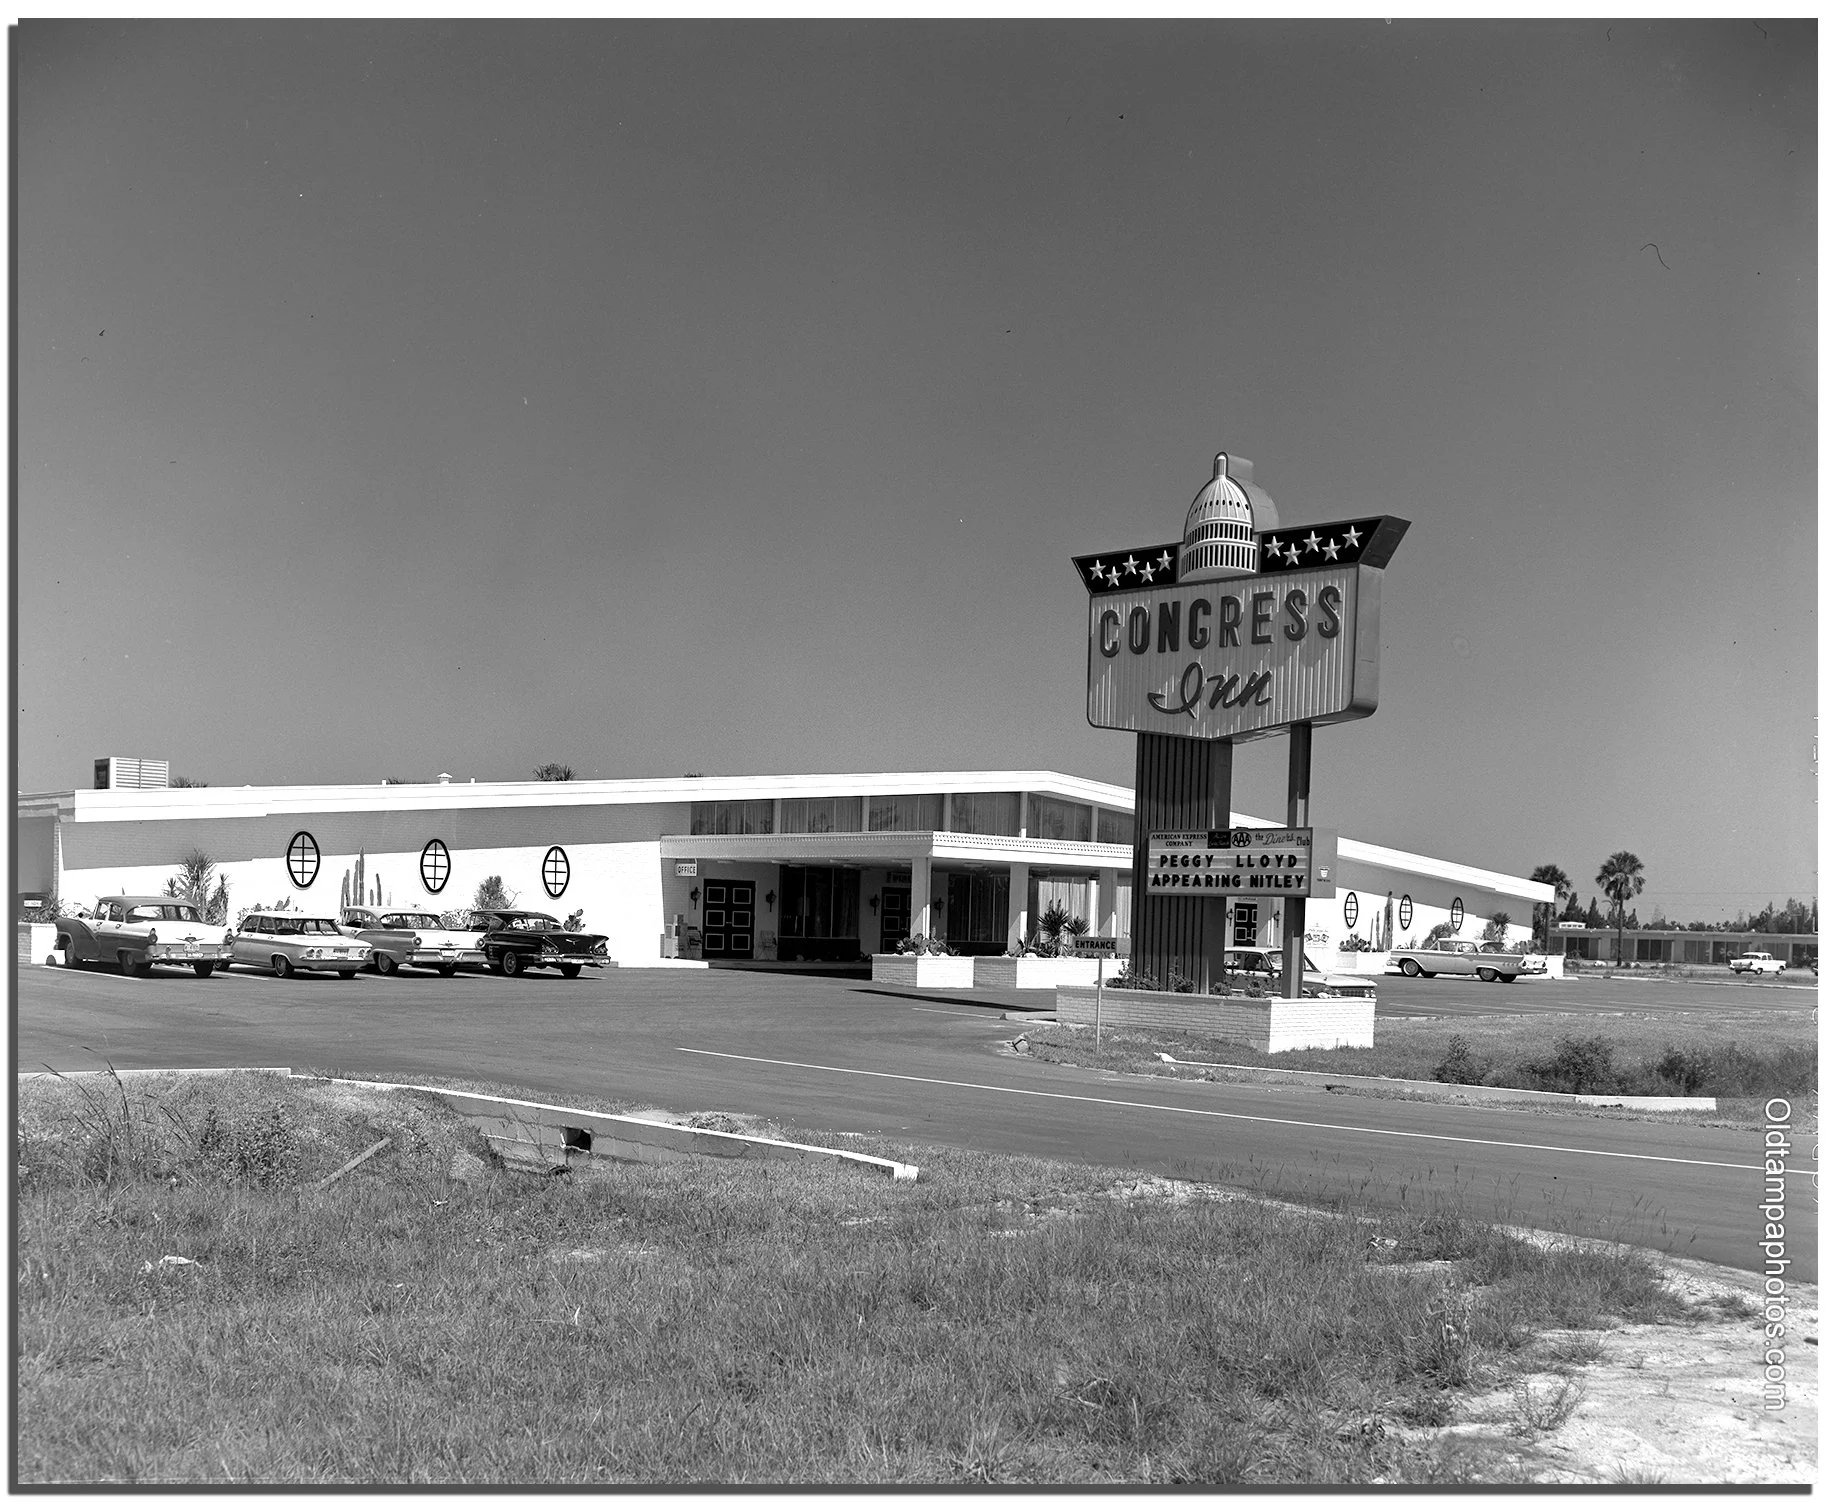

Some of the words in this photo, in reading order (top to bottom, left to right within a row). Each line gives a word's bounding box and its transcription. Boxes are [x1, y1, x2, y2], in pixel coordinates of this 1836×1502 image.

[1100, 585, 1342, 657] CONGRESS
[1147, 662, 1272, 719] Inn
[1232, 832, 1251, 847] AAA
[1160, 855, 1214, 867] PEGGY
[1236, 854, 1298, 867] LLOYD
[677, 865, 697, 875] OFFICE
[1151, 873, 1241, 888] APPEARING
[1250, 874, 1305, 888] NITLEY
[1075, 939, 1117, 951] ENTRANCE
